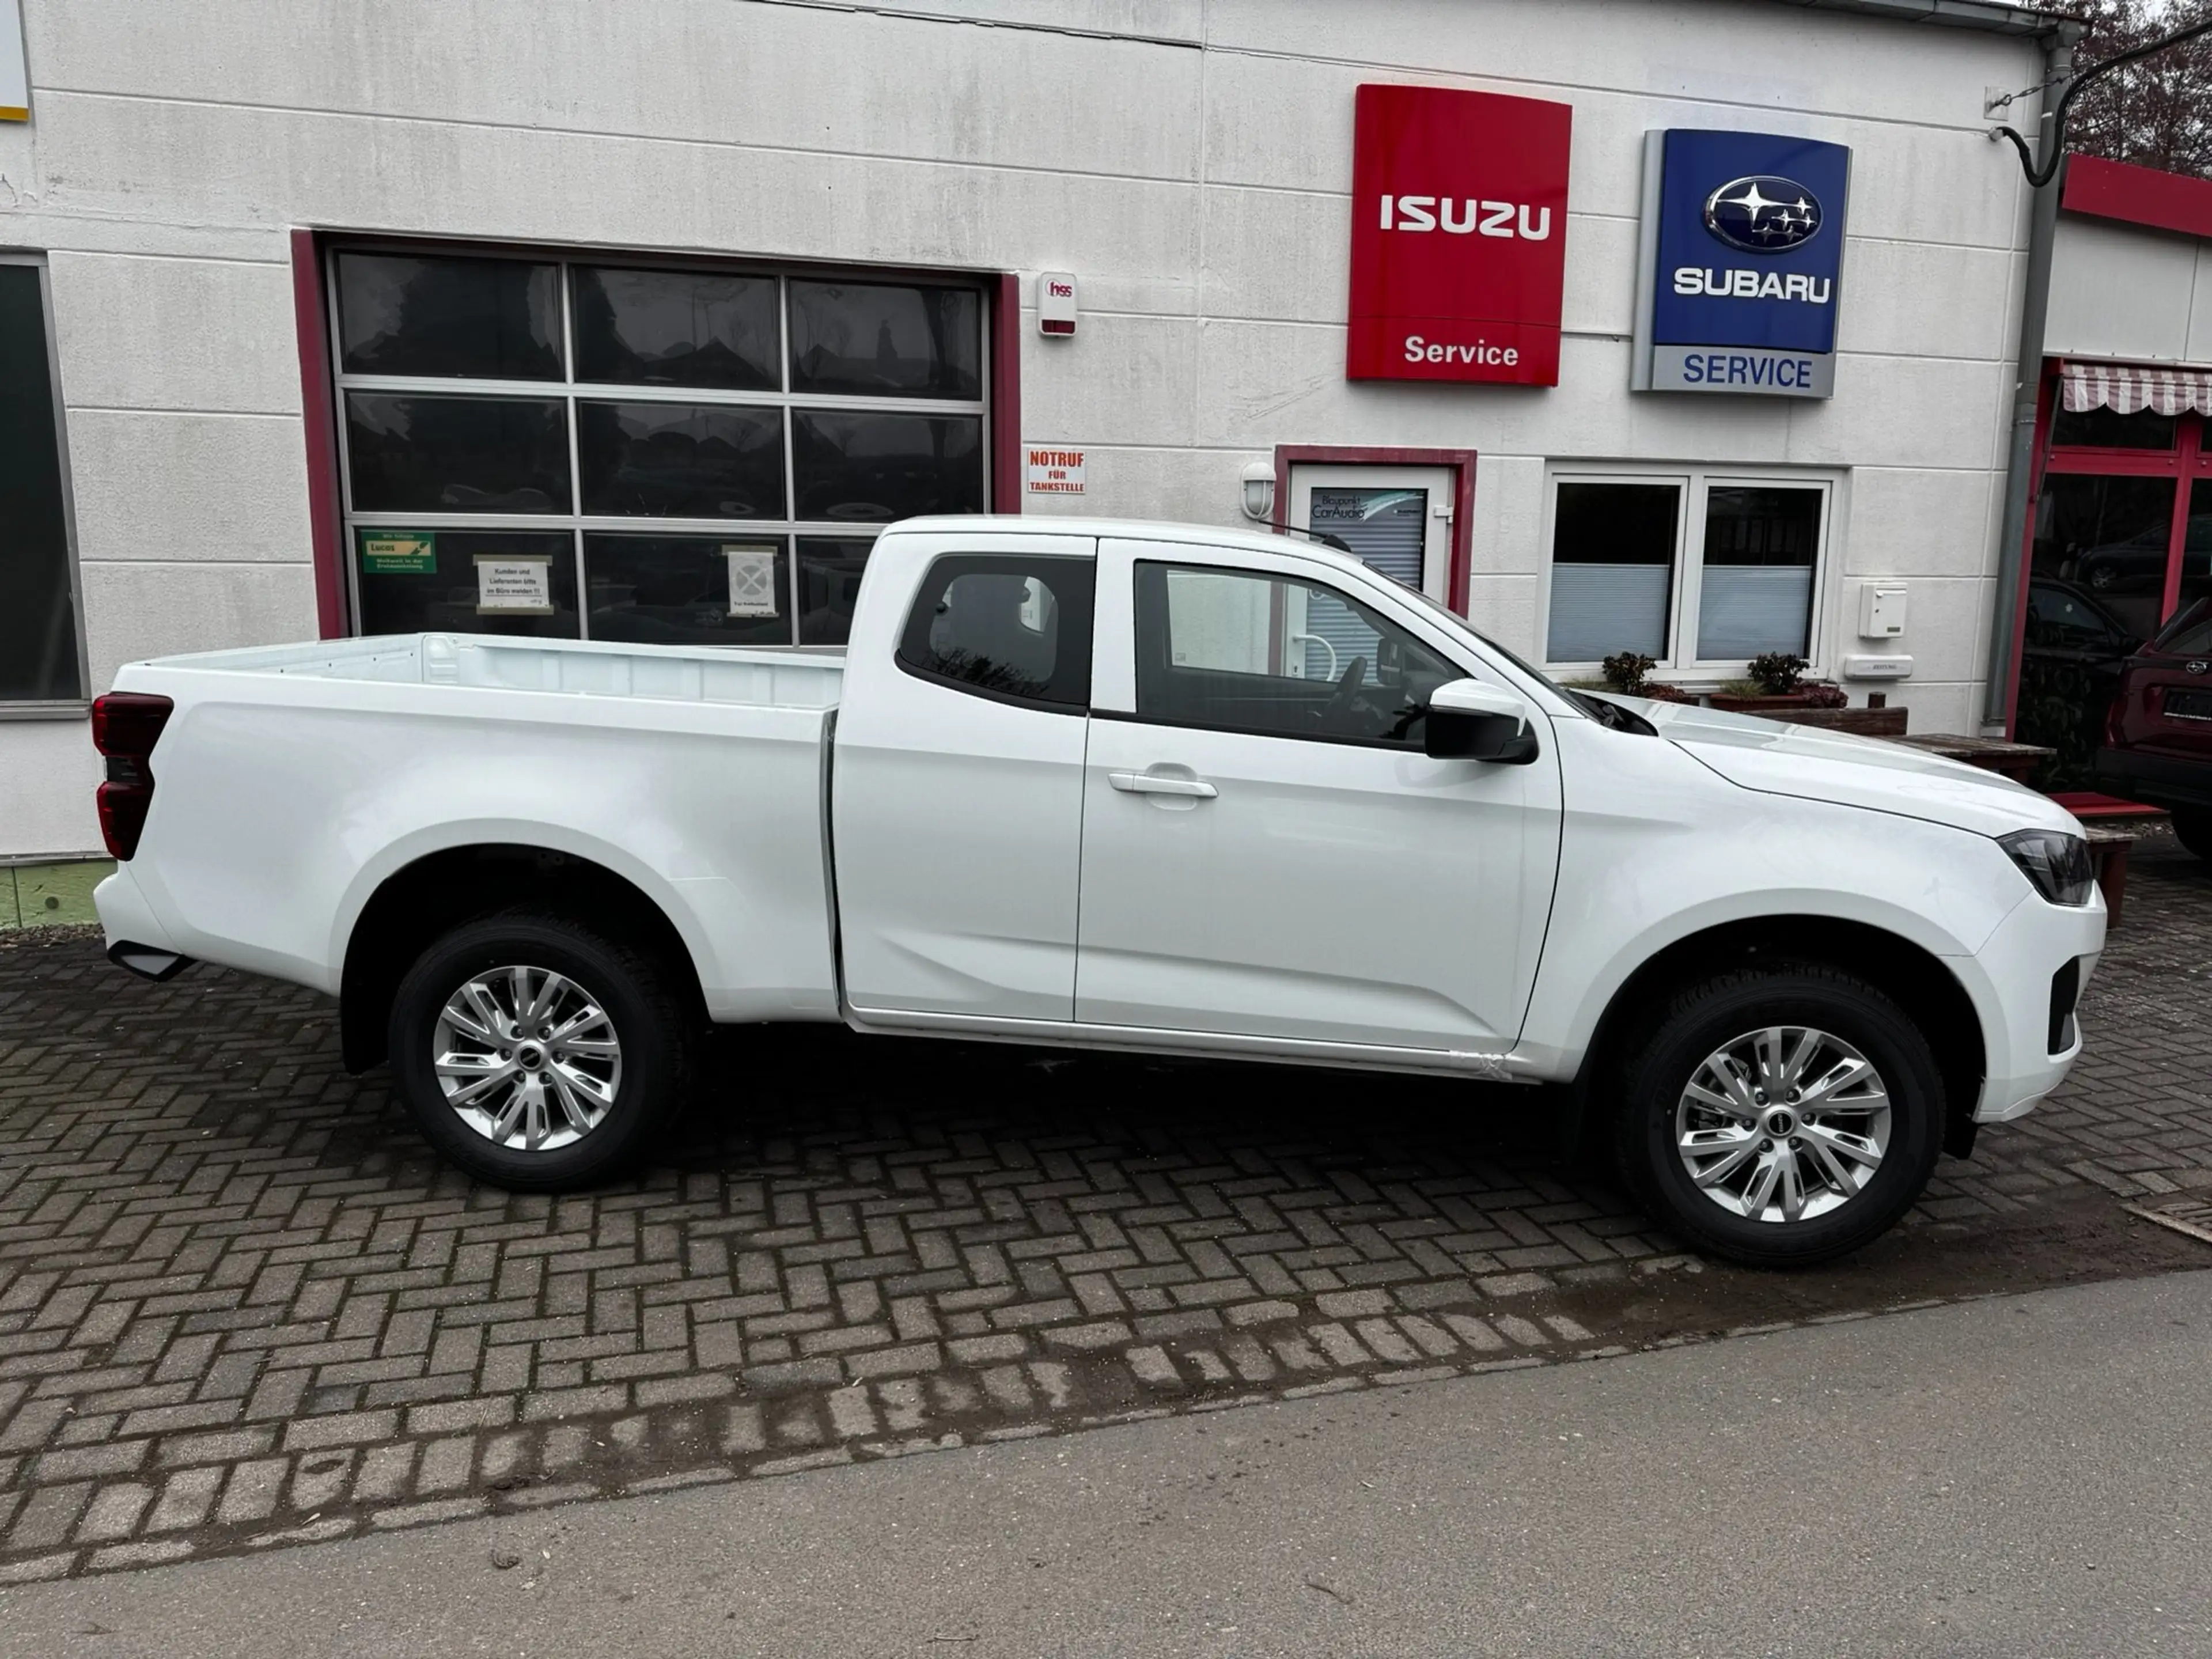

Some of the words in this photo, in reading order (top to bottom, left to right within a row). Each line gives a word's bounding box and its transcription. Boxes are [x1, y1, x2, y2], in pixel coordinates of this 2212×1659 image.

[1380, 194, 1551, 241] ISUZU
[1050, 281, 1073, 298] hss
[1673, 267, 1831, 304] SUBARU
[1404, 335, 1519, 366] Service
[1683, 354, 1813, 389] SERVICE
[1030, 450, 1084, 467] NOTRUF
[1048, 469, 1066, 479] FÜR
[1030, 482, 1085, 492] TANKSTELLE
[1312, 505, 1365, 518] CarAudio
